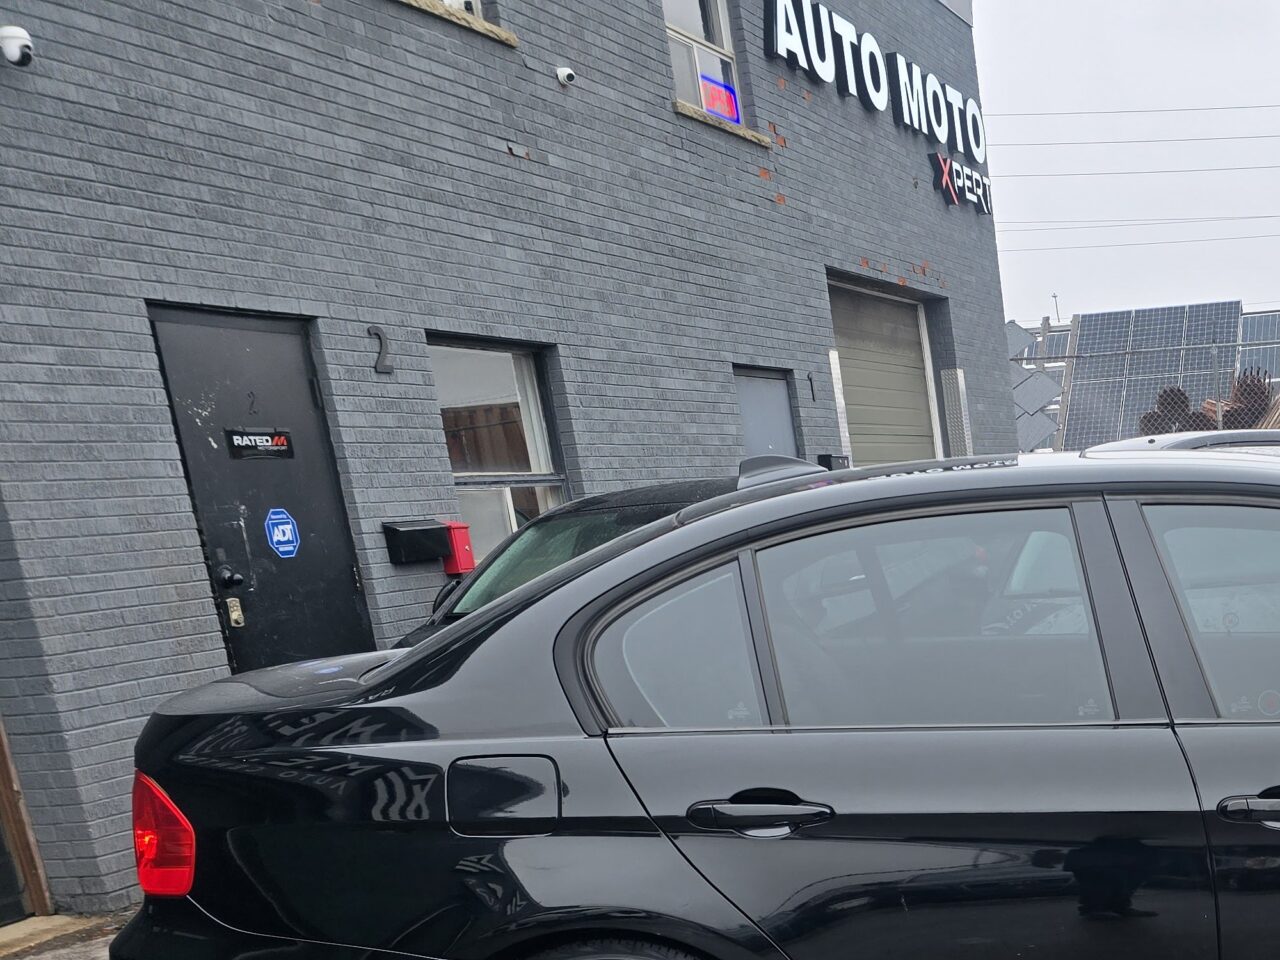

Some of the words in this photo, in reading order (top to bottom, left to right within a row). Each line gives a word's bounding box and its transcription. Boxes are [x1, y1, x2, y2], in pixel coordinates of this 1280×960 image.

[776, 0, 888, 111] AUTO
[896, 53, 986, 164] MOTO
[367, 325, 393, 374] 2
[272, 524, 293, 542] ADT
